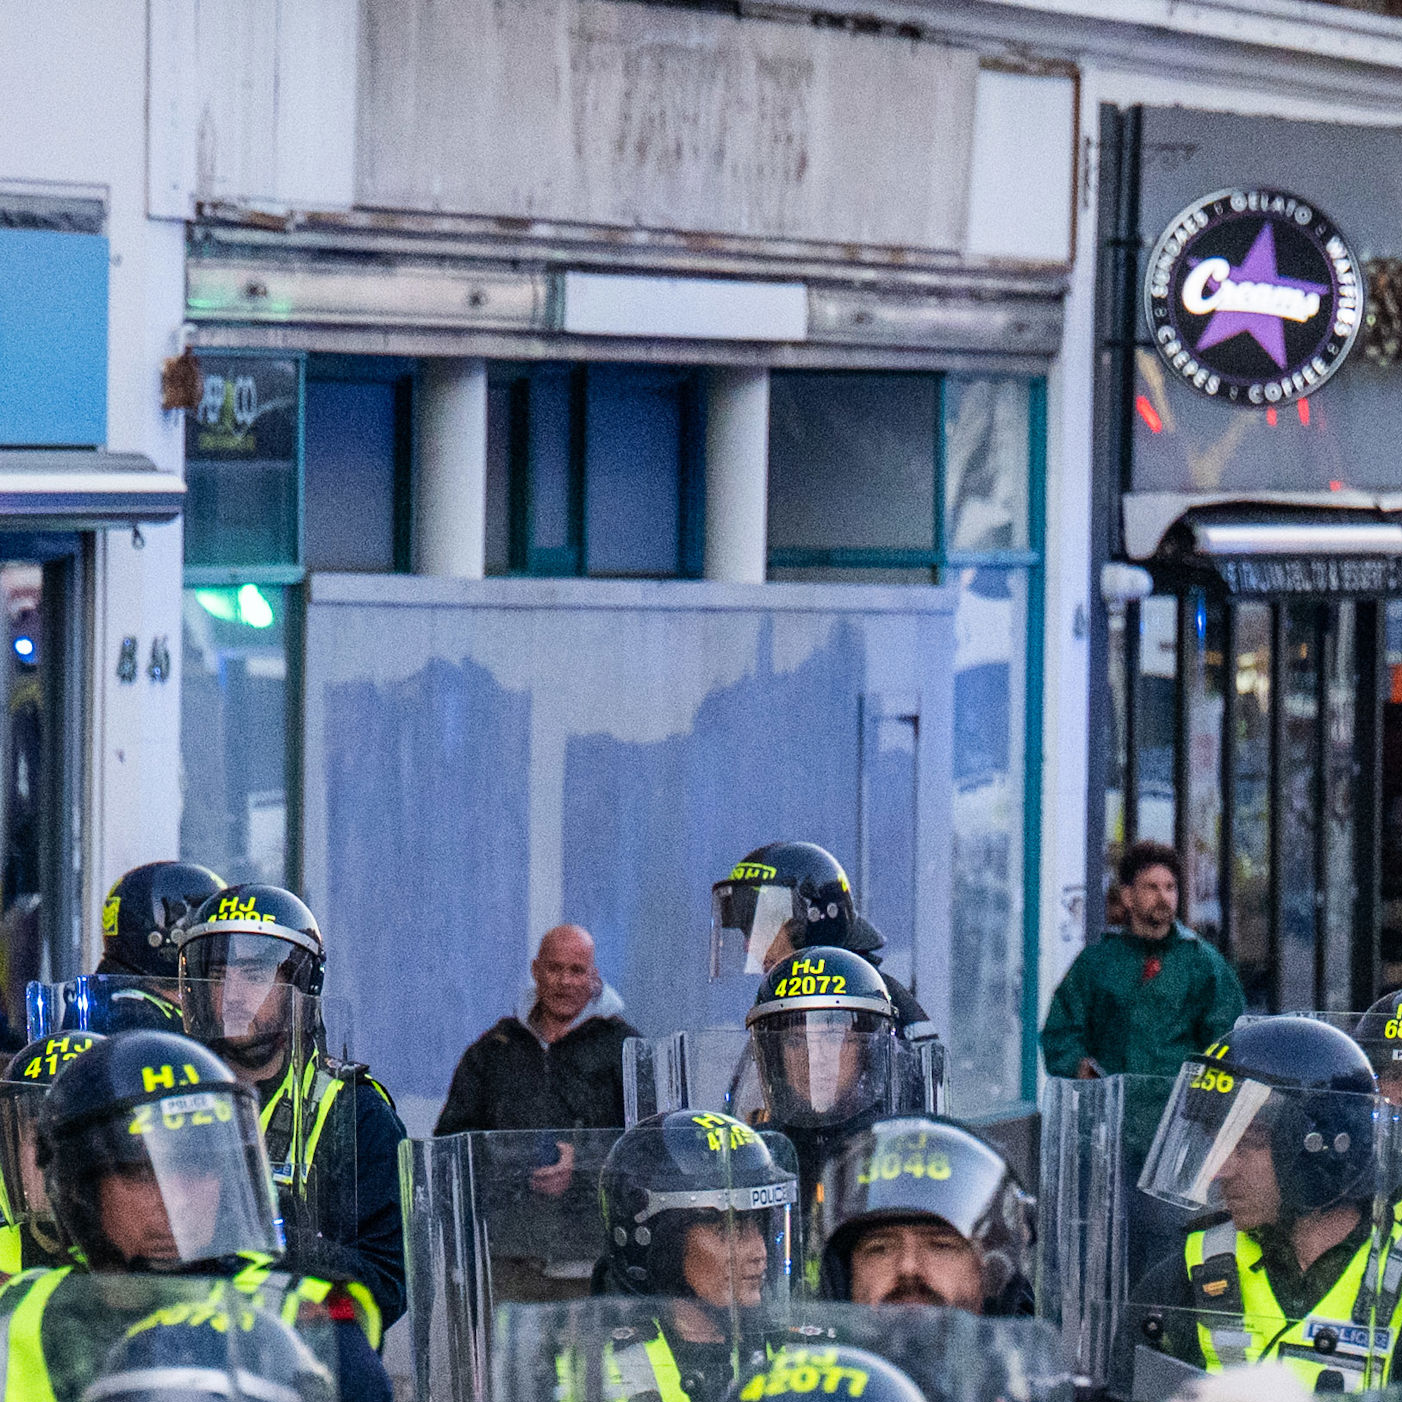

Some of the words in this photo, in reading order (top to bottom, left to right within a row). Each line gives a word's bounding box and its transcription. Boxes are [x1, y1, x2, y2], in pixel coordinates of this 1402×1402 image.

[218, 896, 256, 912] HJ
[792, 959, 826, 976] HJ
[775, 975, 847, 997] 42072
[740, 1364, 869, 1402] 42077
